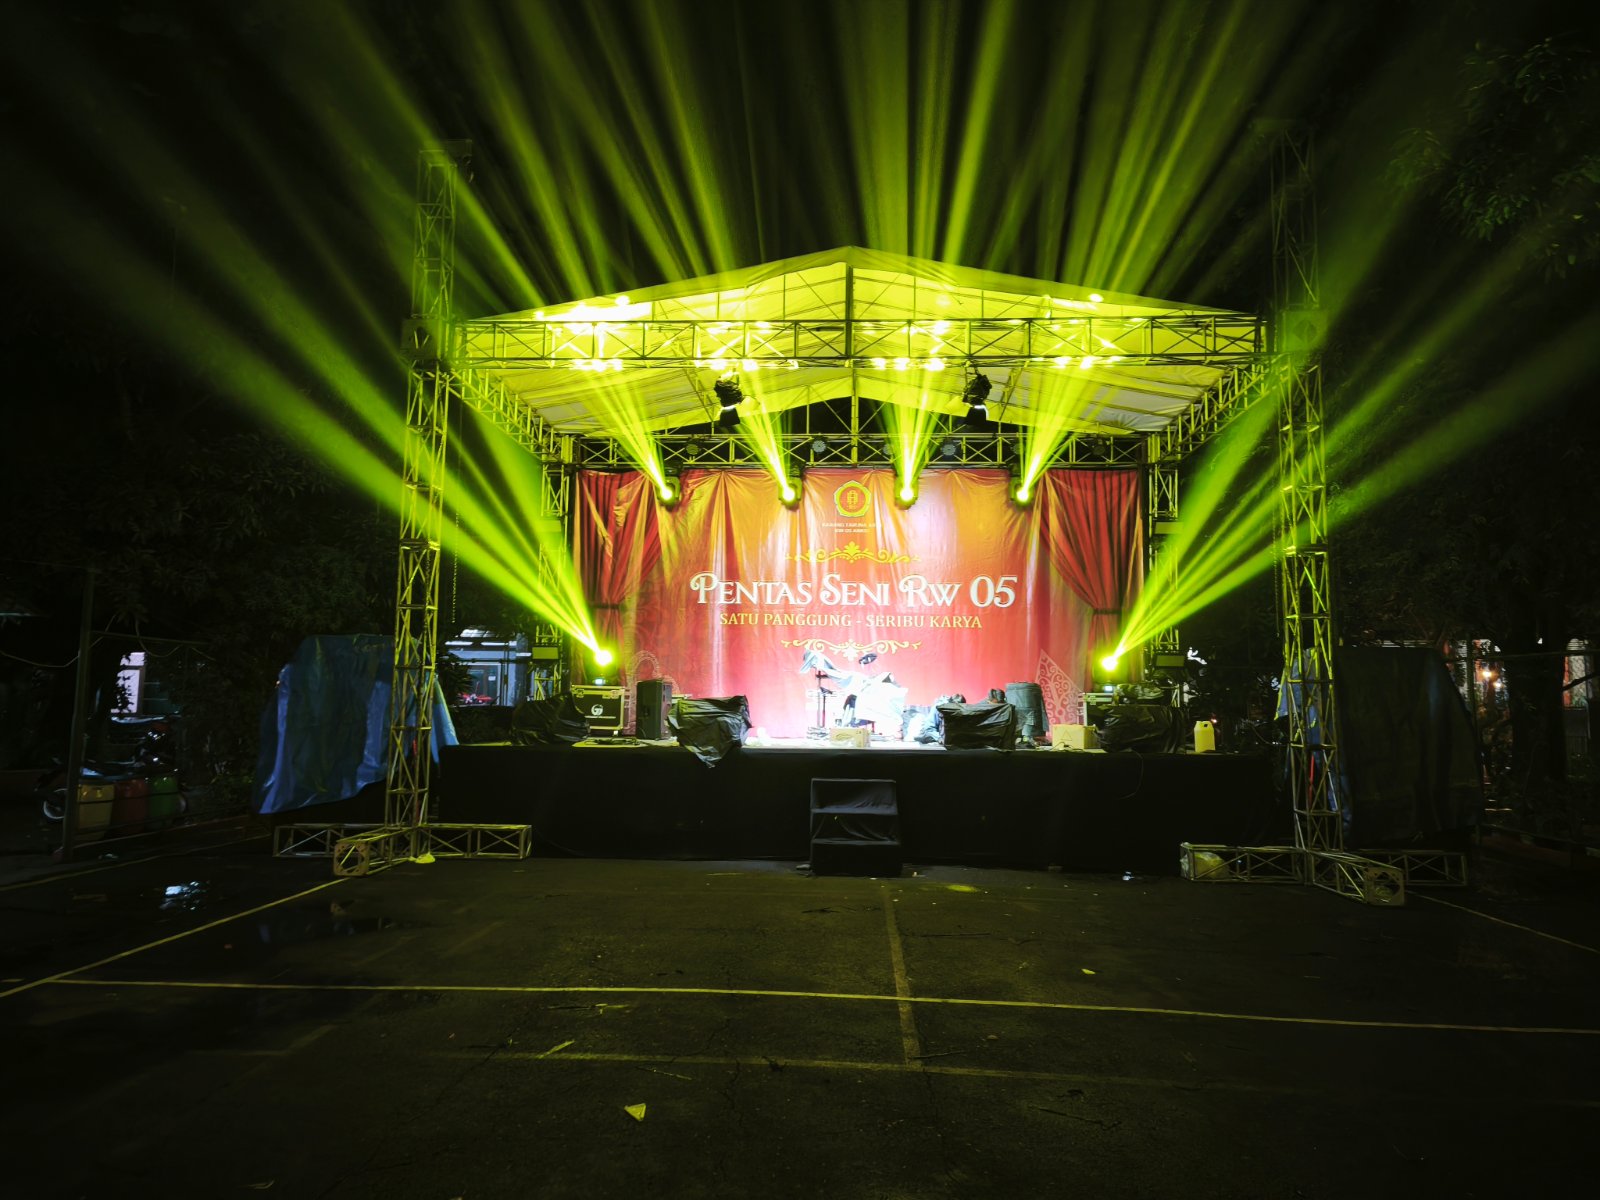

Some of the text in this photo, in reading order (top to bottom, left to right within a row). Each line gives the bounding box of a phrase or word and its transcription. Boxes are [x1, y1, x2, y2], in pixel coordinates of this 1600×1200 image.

[970, 575, 1018, 609] 05
[719, 612, 759, 625] SATU
[764, 613, 852, 627] PANGGUNG
[866, 615, 925, 628] SERIBU
[930, 615, 982, 629] KARYA
